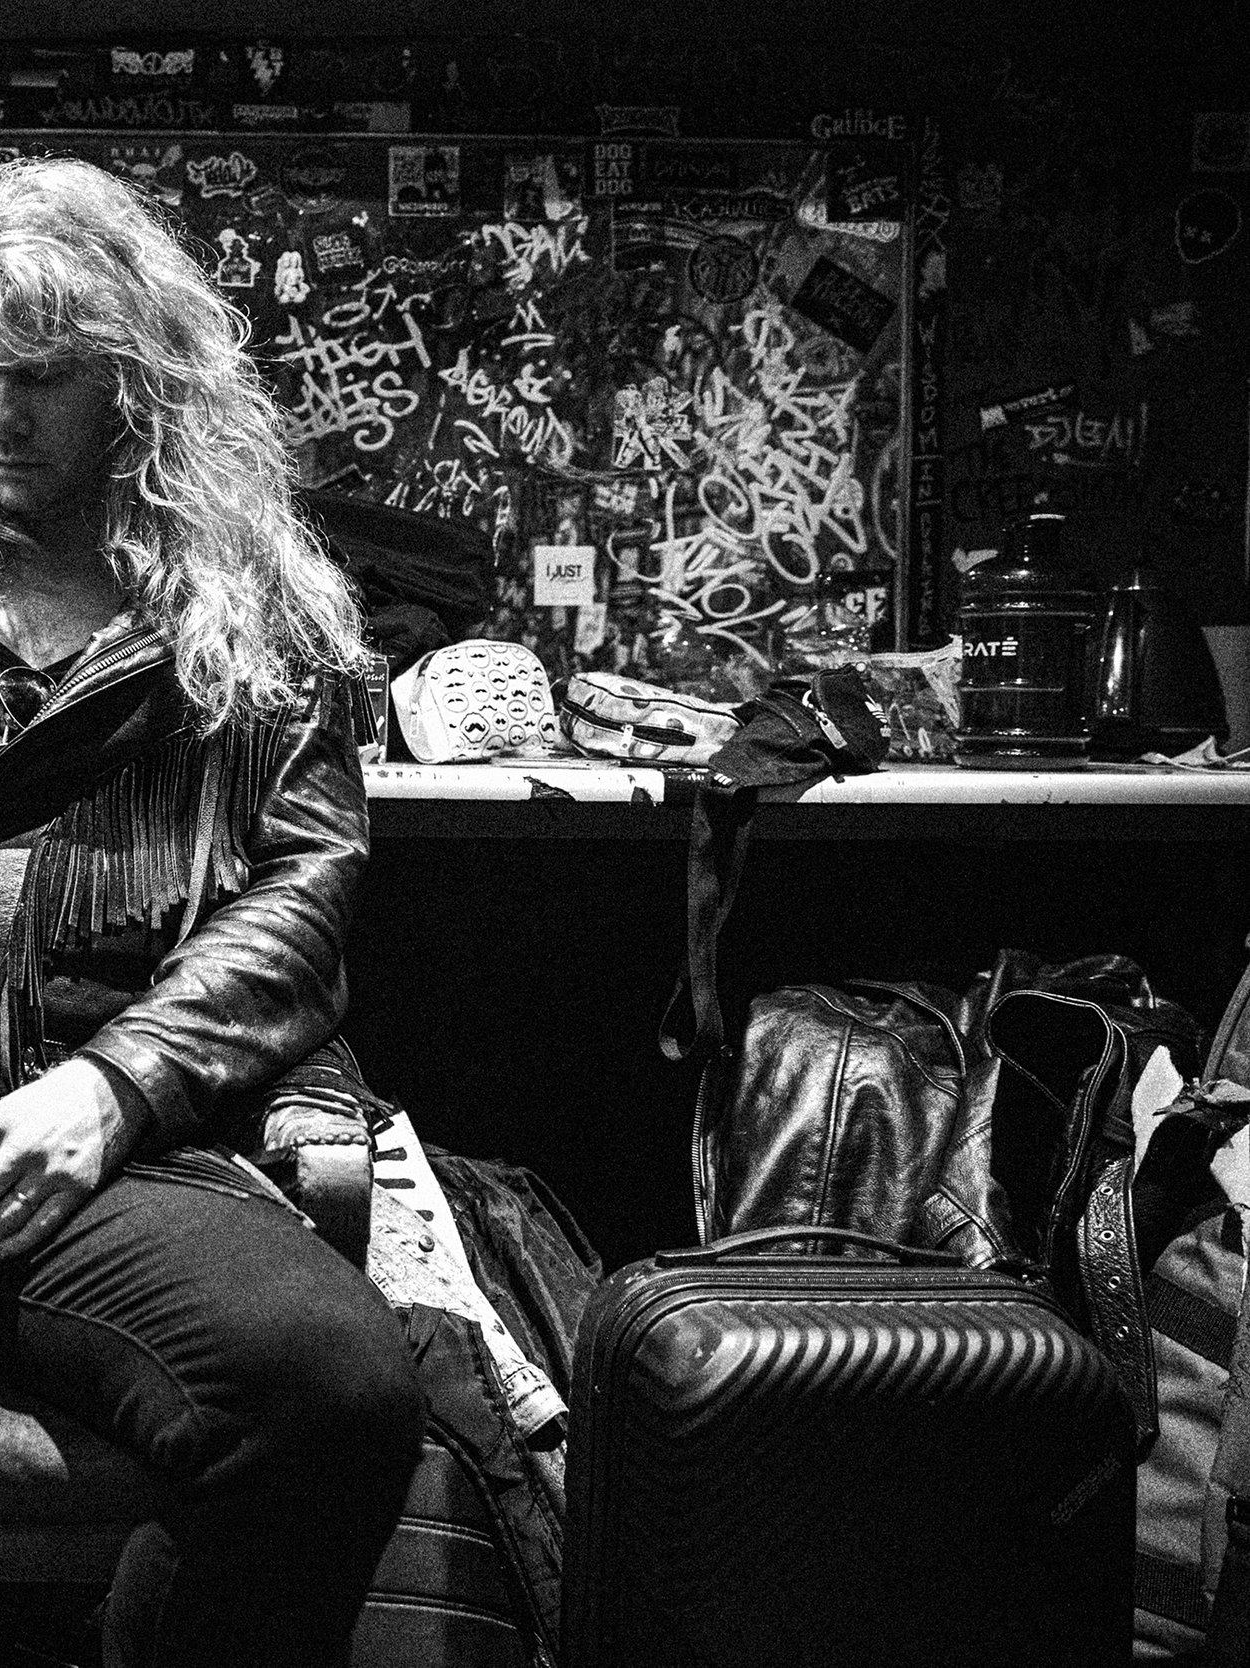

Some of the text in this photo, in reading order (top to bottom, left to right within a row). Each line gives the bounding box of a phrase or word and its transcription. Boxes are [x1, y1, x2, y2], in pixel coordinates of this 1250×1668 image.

[810, 114, 906, 139] GRUDGE
[595, 143, 632, 159] DOG
[595, 161, 632, 177] EAT
[595, 178, 633, 194] DOG
[550, 563, 582, 581] JUST
